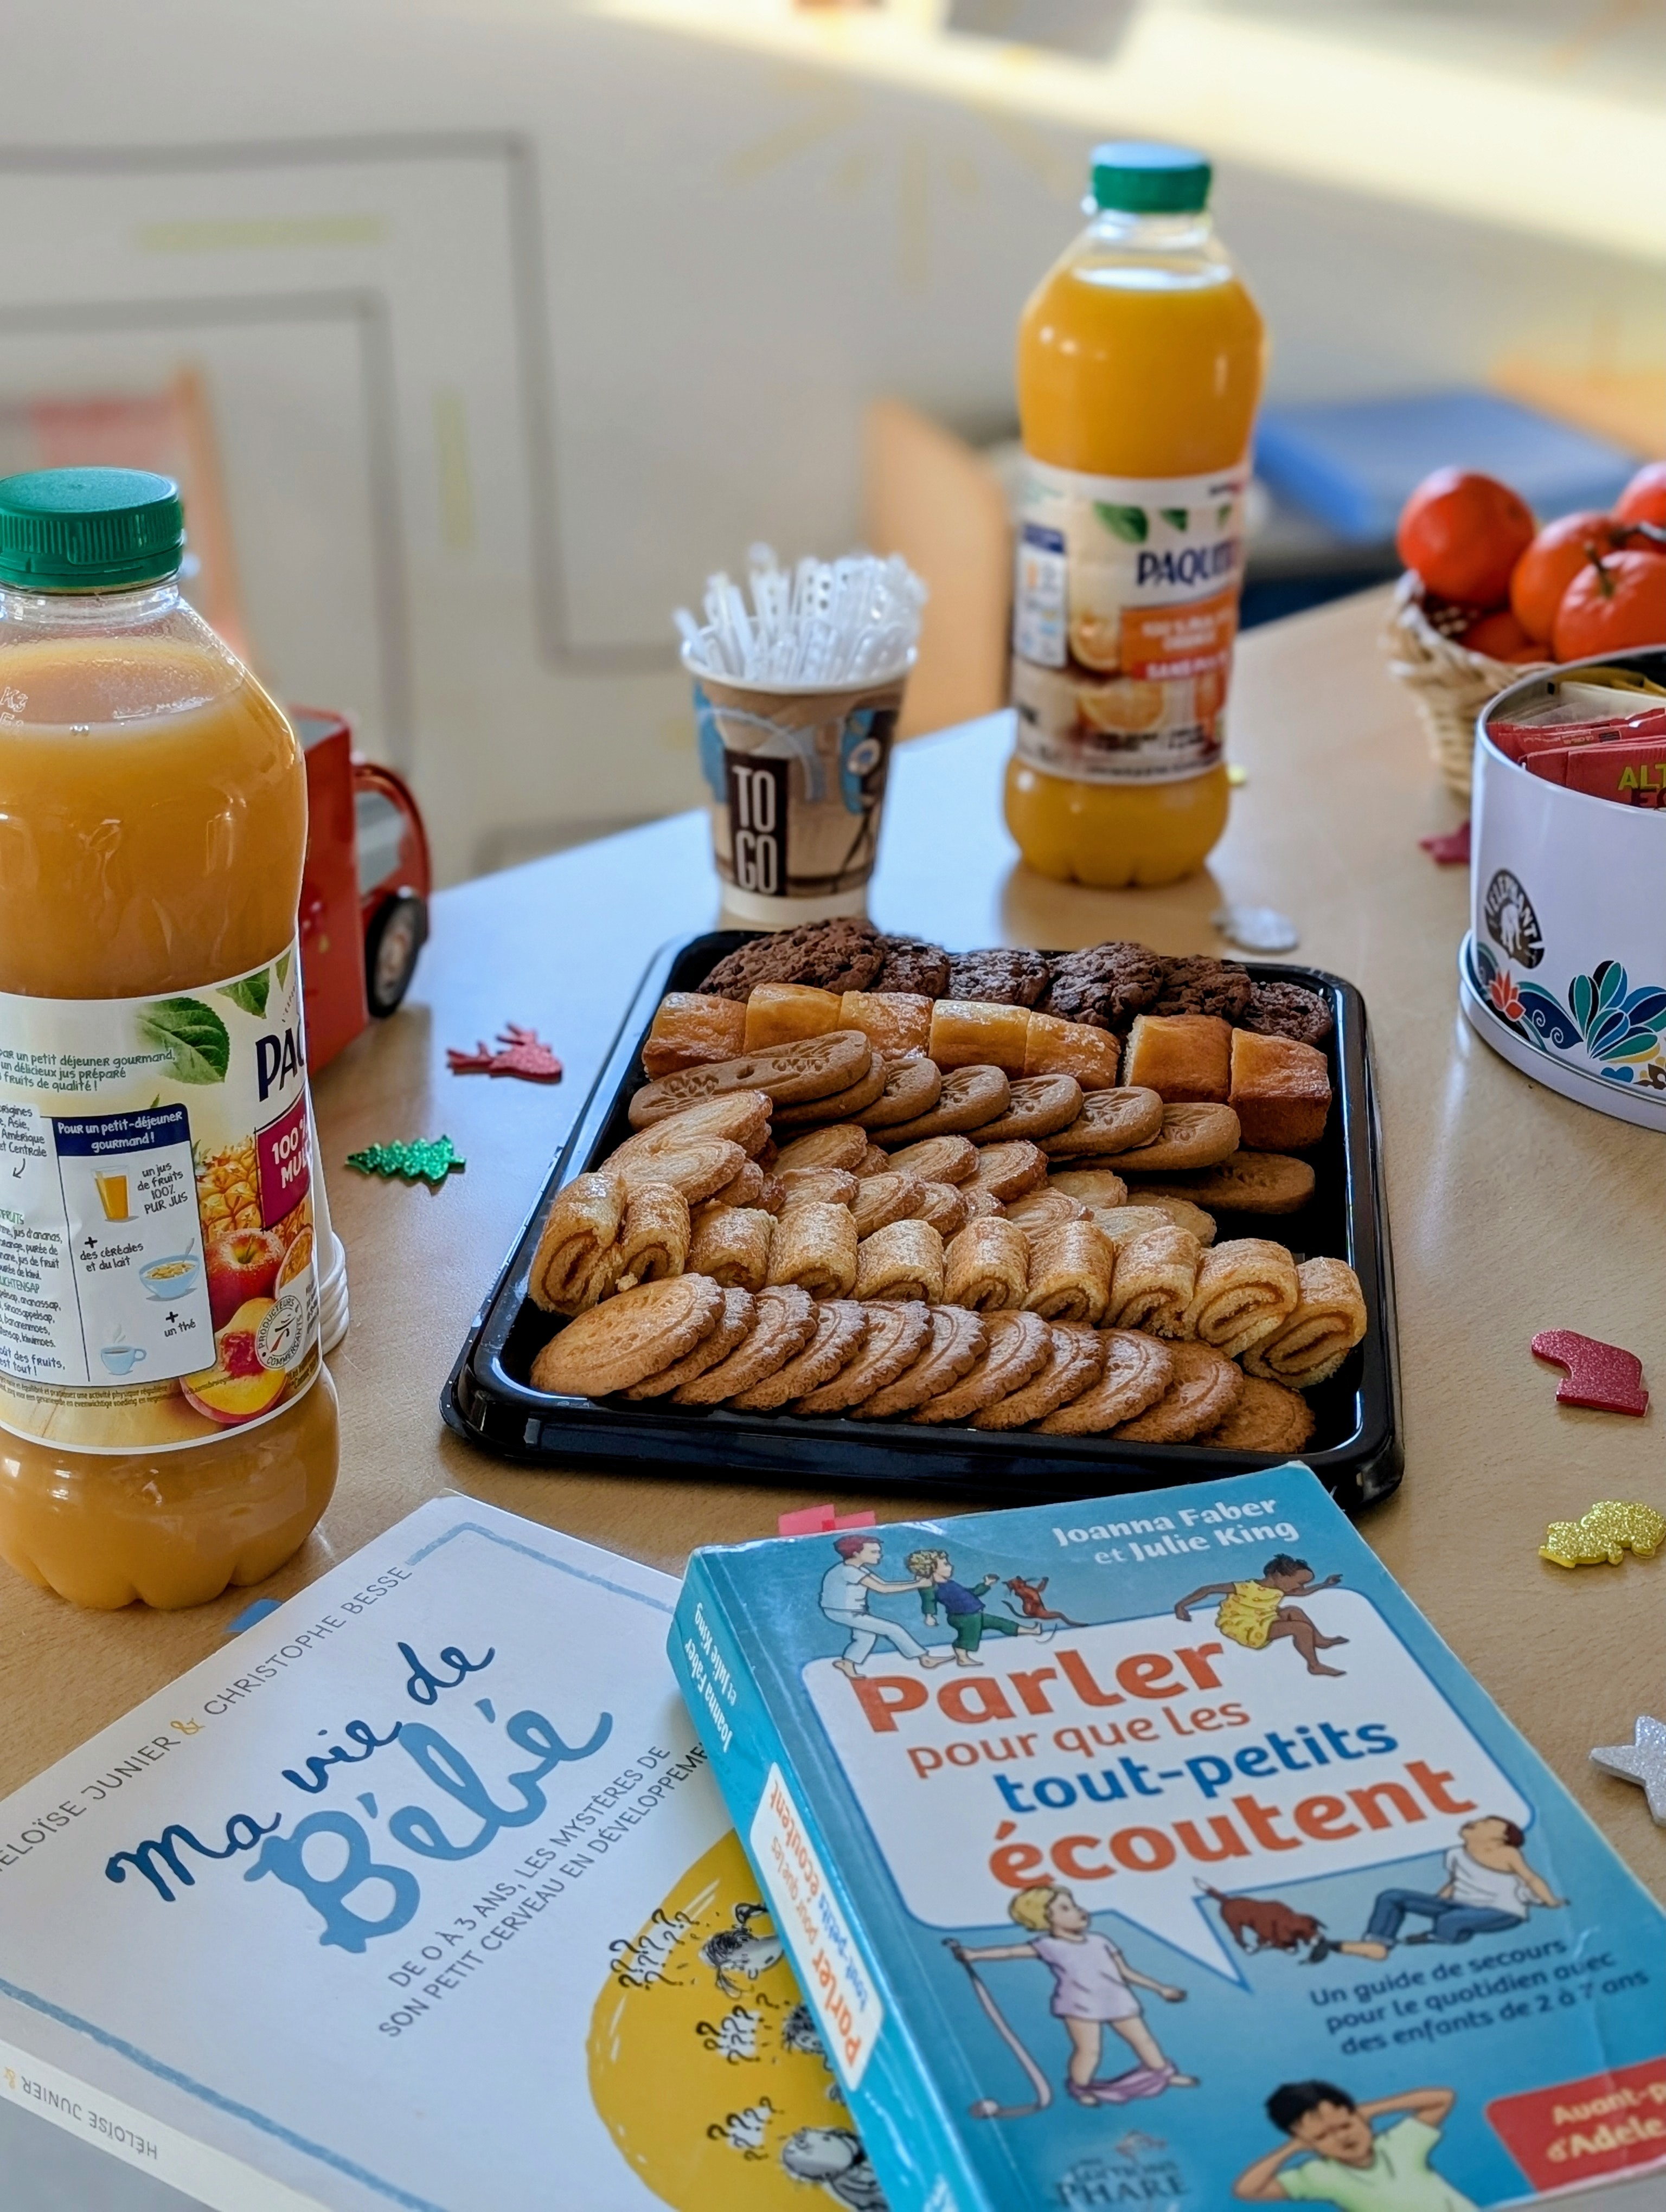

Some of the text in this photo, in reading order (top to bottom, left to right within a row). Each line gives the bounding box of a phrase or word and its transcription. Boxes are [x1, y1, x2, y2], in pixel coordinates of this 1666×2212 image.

[732, 765, 776, 833] TO
[736, 829, 777, 894] GO
[1, 1061, 12, 1070] un
[14, 1063, 56, 1077] délicieux
[59, 1068, 76, 1080] jus
[79, 1069, 126, 1082] préparé
[4, 1072, 34, 1087] fruits
[37, 1078, 49, 1089] de
[52, 1081, 92, 1092] qualité
[16, 1052, 29, 1061] un
[31, 1054, 56, 1065] petit
[60, 1056, 110, 1069] déjeuner
[113, 1051, 175, 1068] gourmand,
[57, 1111, 183, 1135] Pour un petit-déjeuner
[137, 1171, 183, 1191] de fruits
[142, 1163, 172, 1178] un jus
[151, 1184, 176, 1200] 100%
[144, 1192, 188, 1214] PUR JUS
[49, 1244, 58, 1255] de
[80, 1242, 144, 1261] des céréales
[86, 1256, 130, 1272] et du lait
[164, 1319, 196, 1338] un thé
[13, 1361, 31, 1375] tout
[14, 1351, 29, 1363] des
[31, 1354, 65, 1370] fruits,
[1052, 1498, 1277, 1547] Joanna Faber
[1094, 1522, 1299, 1565] et Julie King
[695, 1602, 736, 1706] et Julie King
[81, 1735, 181, 1801] JUNIER
[203, 1615, 346, 1715] CHRISTOPHE
[341, 1566, 413, 1616] BESSE
[684, 1638, 732, 1753] Joanna Faber
[850, 1641, 1225, 1733] Parler
[906, 1700, 1251, 1779] pour que les
[106, 1642, 496, 1903] Ma vie de
[993, 1721, 1399, 1815] tout-petits
[989, 1759, 1477, 1890] écoutent
[379, 1741, 708, 2038] SON PETIT CERVEAU EN DÉVELOPPEME
[388, 1960, 427, 1989] DE
[435, 1929, 464, 1947] À
[453, 1917, 477, 1931] 3
[473, 1881, 528, 1919] ANS,
[514, 1847, 557, 1880] LES
[549, 1769, 644, 1848] MYSTÈRES
[637, 1745, 671, 1770] DE
[1310, 1940, 1567, 2006] Un guide de secours
[1327, 1954, 1616, 2035] pour le quotidien avec
[812, 1947, 861, 2066] Parler
[1342, 2037, 1388, 2055] des
[1393, 2011, 1494, 2043] enfants
[1500, 2002, 1530, 2020] de
[1535, 1995, 1552, 2012] 2
[1603, 1970, 1649, 1995] ans
[21, 2076, 82, 2121] JUNIER
